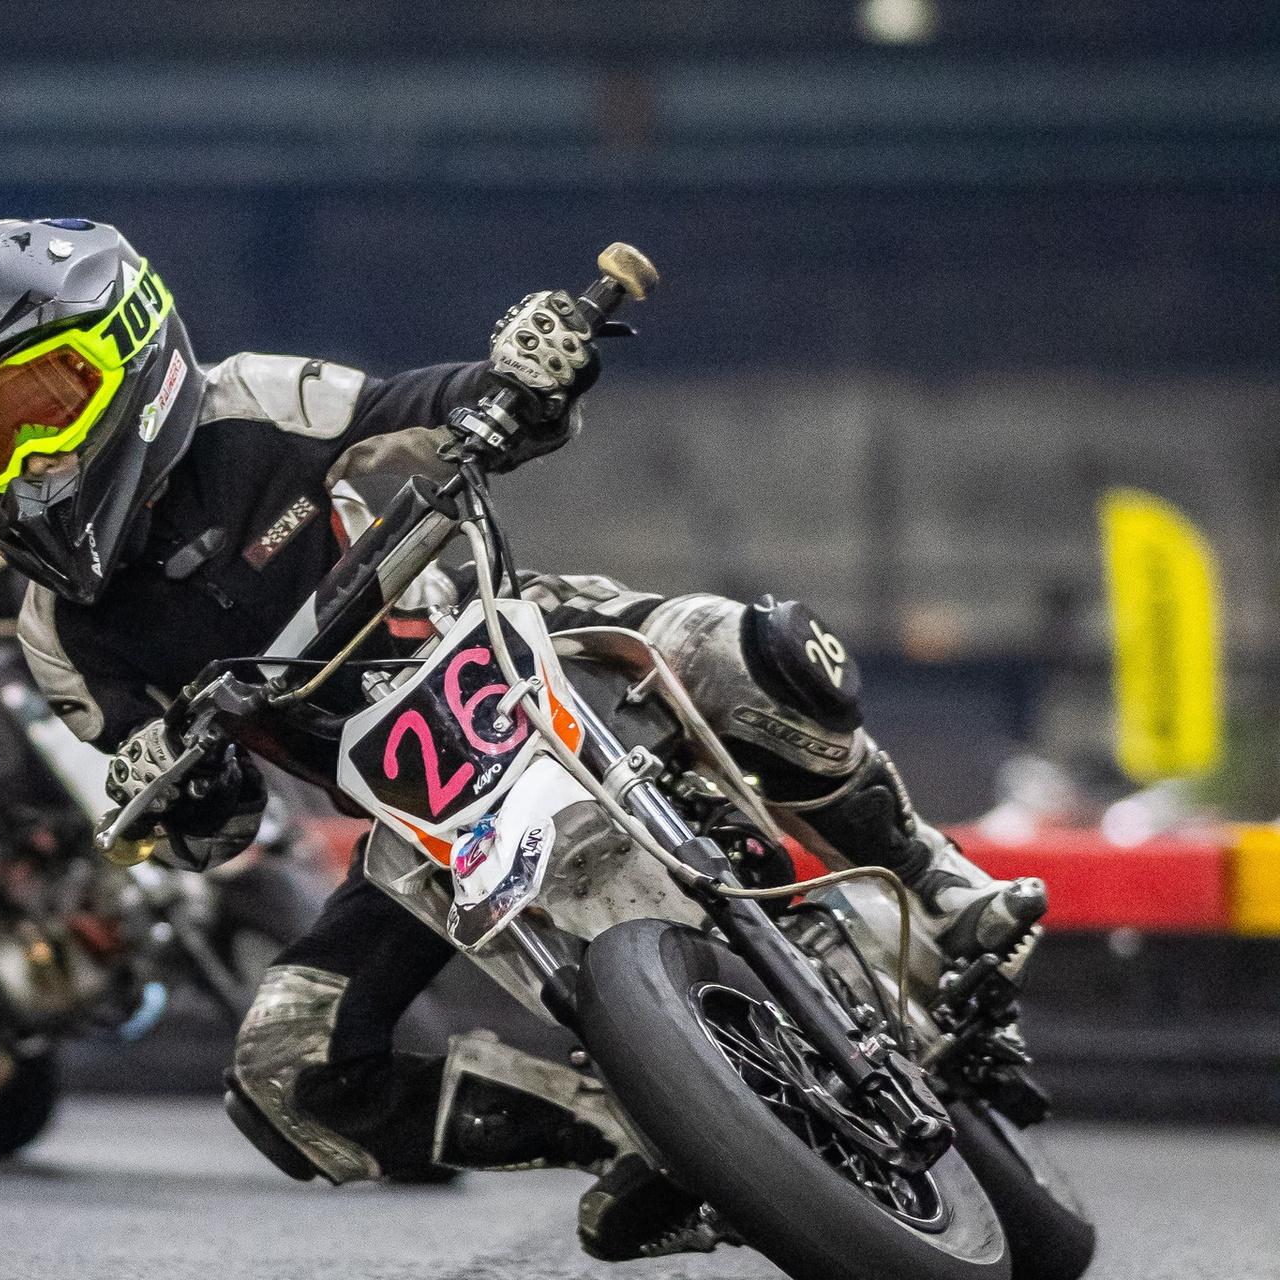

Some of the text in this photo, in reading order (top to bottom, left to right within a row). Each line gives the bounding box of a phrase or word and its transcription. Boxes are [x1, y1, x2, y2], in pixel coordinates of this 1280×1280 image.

[805, 619, 846, 688] 26
[382, 646, 529, 817] 26
[473, 763, 502, 795] KAYO
[521, 828, 544, 858] KAYO
